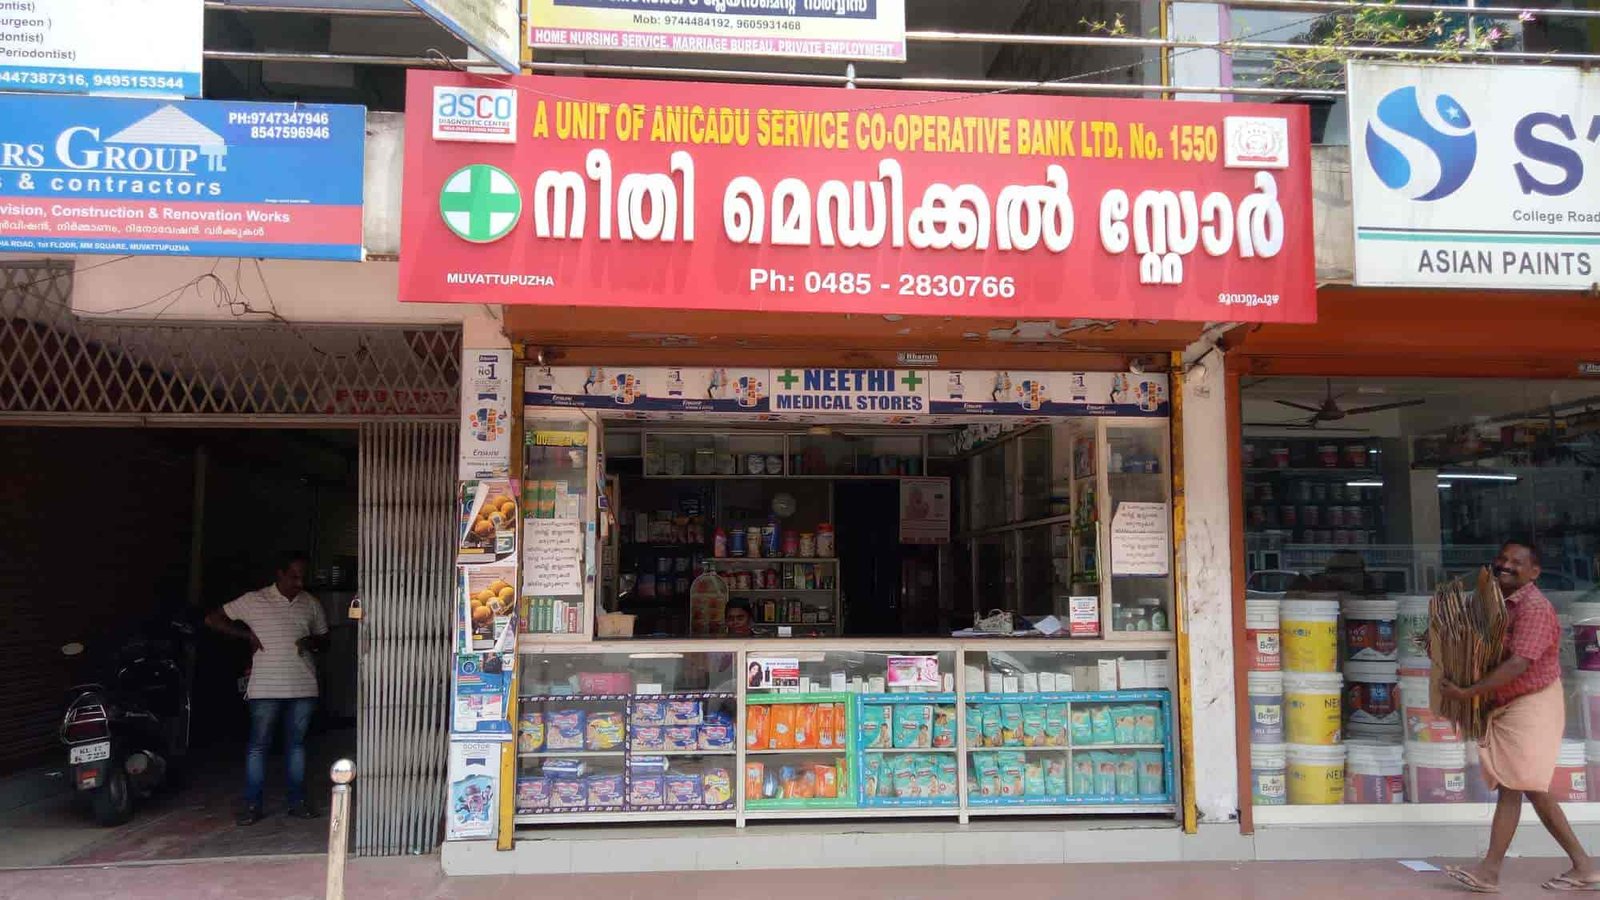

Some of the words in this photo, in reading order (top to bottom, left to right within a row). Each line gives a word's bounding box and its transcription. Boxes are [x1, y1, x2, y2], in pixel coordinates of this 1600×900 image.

[633, 14, 660, 25] Mob:
[665, 15, 733, 29] 9744484192,
[737, 20, 801, 31] 9605931468
[535, 29, 567, 43] HOME
[570, 31, 618, 46] NURSING
[672, 36, 729, 51] MARRIAGE
[778, 41, 822, 54] PRIVATE
[0, 71, 89, 87] 447387316,
[93, 74, 184, 89] 9495153544
[229, 111, 330, 125] PH:9747347946
[251, 126, 330, 139] 8547596946
[532, 100, 550, 138] A
[556, 101, 610, 141] UNIT
[615, 102, 646, 141] OF
[650, 104, 750, 146] ANICADU
[756, 107, 849, 149] SERVICE
[855, 112, 1011, 155] CO-OPERATIVE
[1017, 117, 1076, 157] BANK
[1081, 120, 1124, 159] LTD.
[1129, 122, 1164, 160] No.
[1169, 125, 1218, 162] 1550
[19, 172, 35, 190] &
[51, 175, 222, 197] contractors
[533, 148, 695, 242] നീതി
[722, 157, 1075, 253] മെഡിക്കൽ
[52, 205, 144, 219] Construction
[148, 207, 158, 220] &
[163, 207, 242, 222] Renovation
[246, 210, 290, 223] Works
[1512, 210, 1563, 224] College
[1568, 210, 1600, 223] Road
[130, 243, 191, 253] MUVATTUPUZHA
[1418, 249, 1493, 274] ASIAN
[1503, 251, 1592, 275] PAINTS
[446, 272, 555, 286] MUVATTUPUZHA
[750, 268, 795, 293] Ph:
[804, 271, 871, 294] 0485
[899, 273, 1015, 297] 2830766
[804, 369, 896, 392] NEETHI
[776, 394, 852, 410] MEDICAL
[856, 395, 923, 411] STORES
